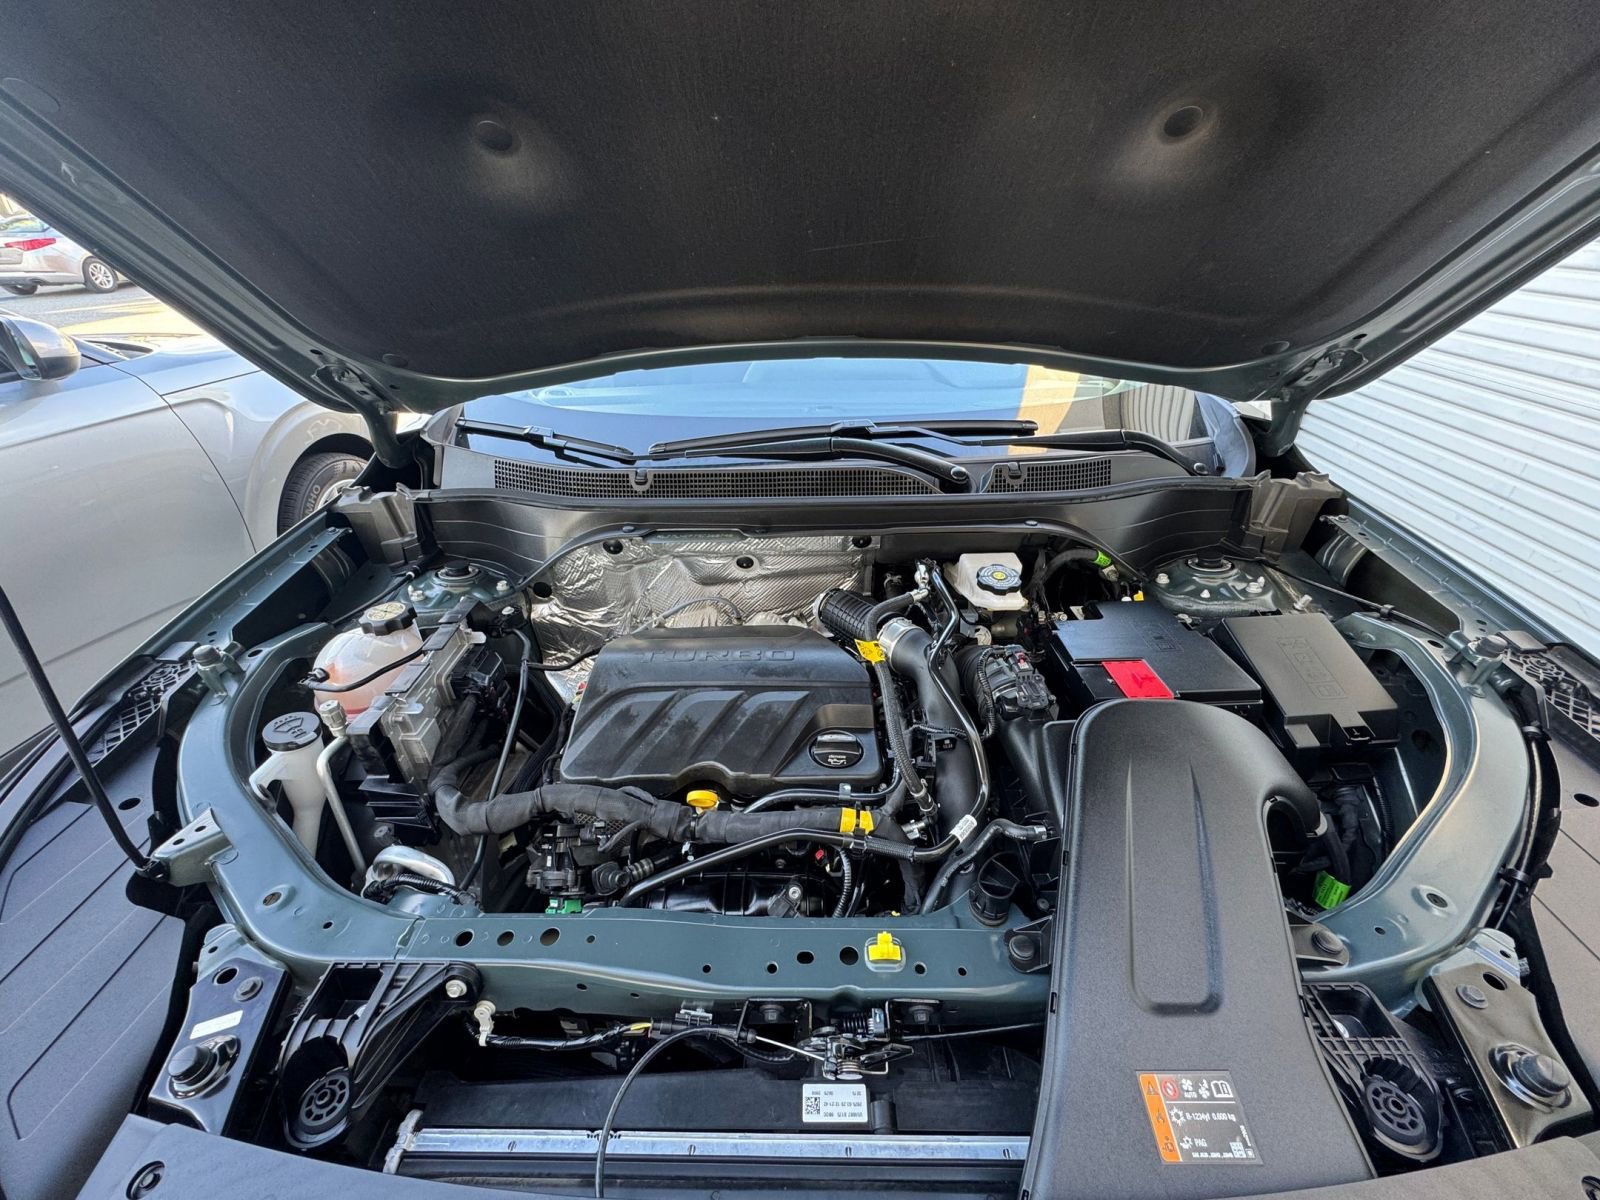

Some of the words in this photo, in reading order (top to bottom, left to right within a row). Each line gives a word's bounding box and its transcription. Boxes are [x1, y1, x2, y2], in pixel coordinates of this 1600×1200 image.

[305, 484, 321, 516] MHO
[640, 649, 796, 664] TURBO
[1193, 1138, 1207, 1147] PAG
